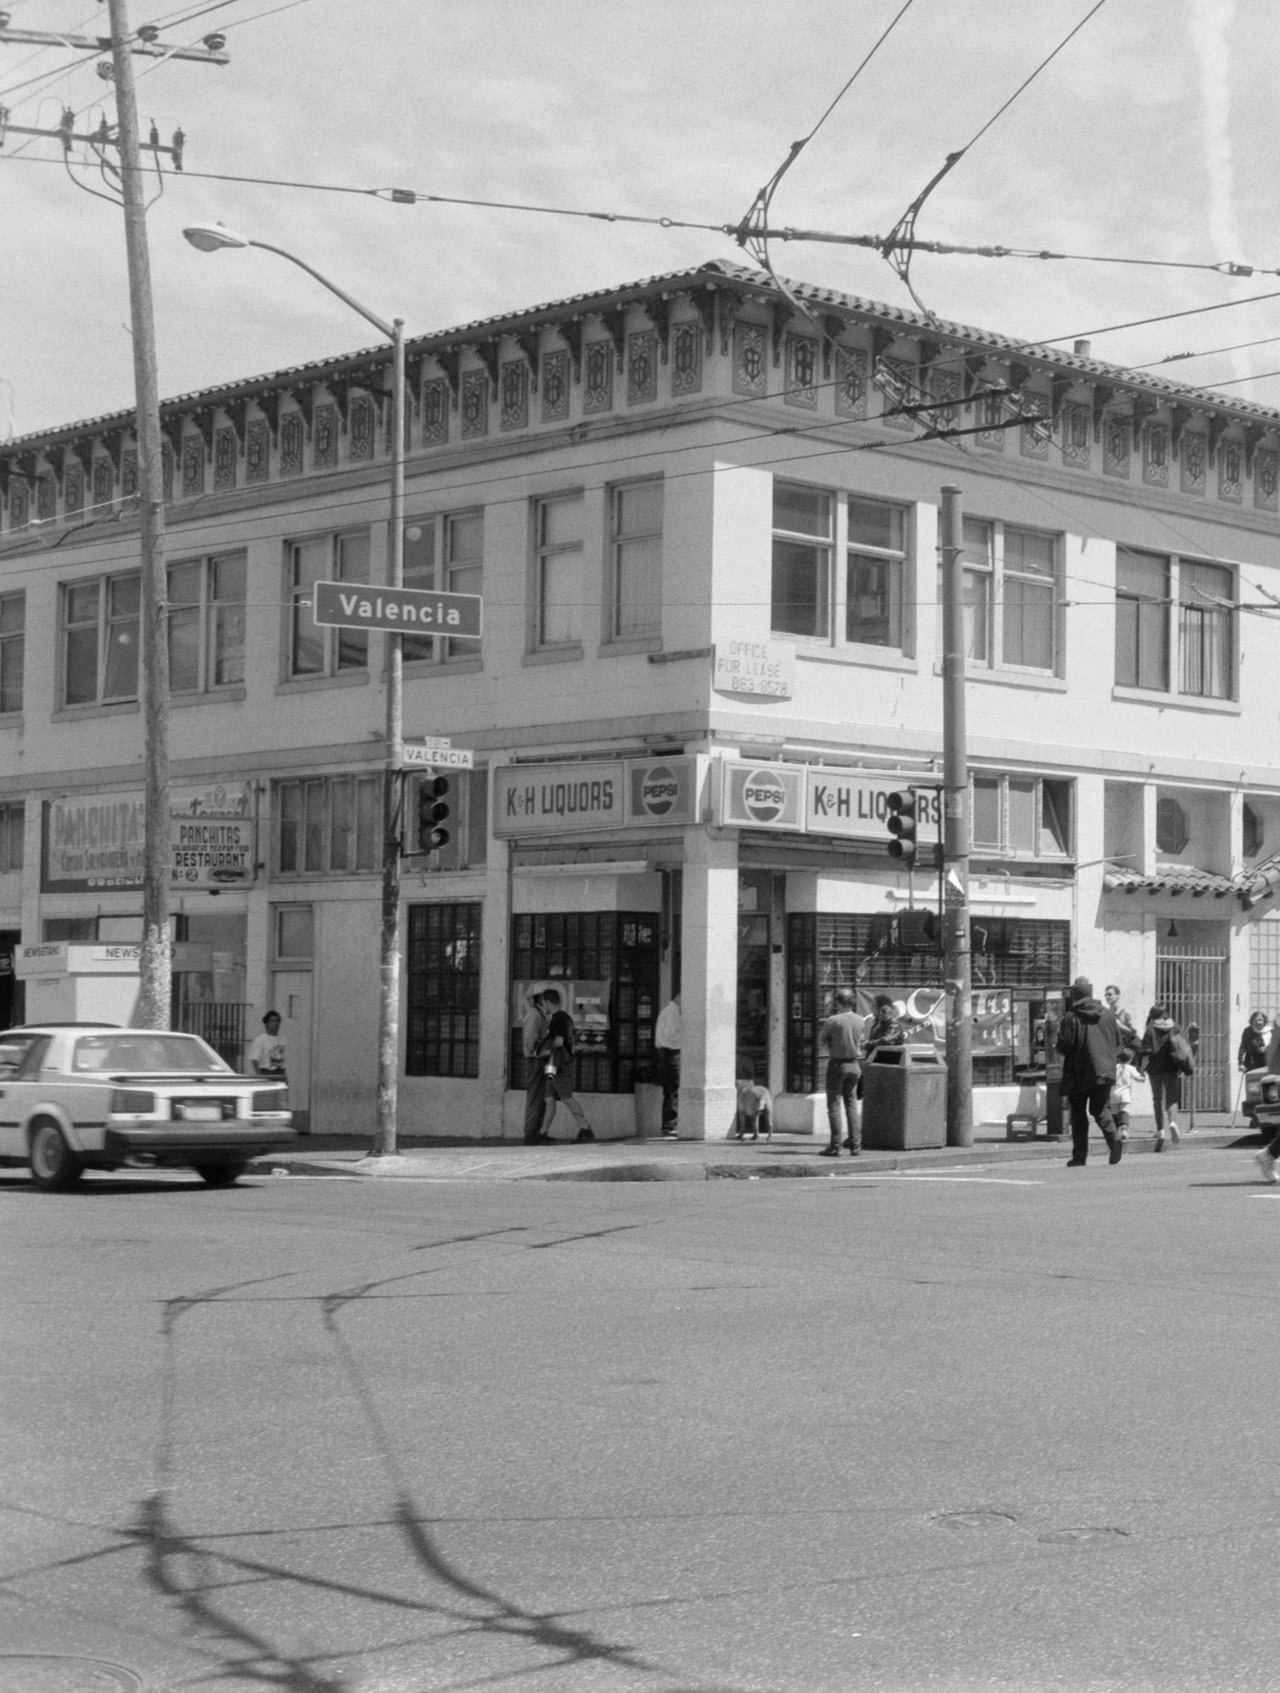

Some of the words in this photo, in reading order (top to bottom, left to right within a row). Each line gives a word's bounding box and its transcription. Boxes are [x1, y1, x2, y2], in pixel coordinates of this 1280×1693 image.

[339, 594, 461, 625] Valencia
[729, 641, 769, 659] OFFICE
[718, 658, 741, 673] FOR
[745, 660, 781, 678] LEASE
[407, 749, 469, 765] VALENCIA
[542, 780, 614, 817] LIQUORS
[643, 783, 678, 798] PEPSI
[745, 788, 785, 804] PEPSI
[814, 785, 850, 818] K&H
[858, 789, 942, 824] LIQRS
[180, 825, 241, 844] PANCHITAS
[176, 852, 246, 867] RESTAURANT
